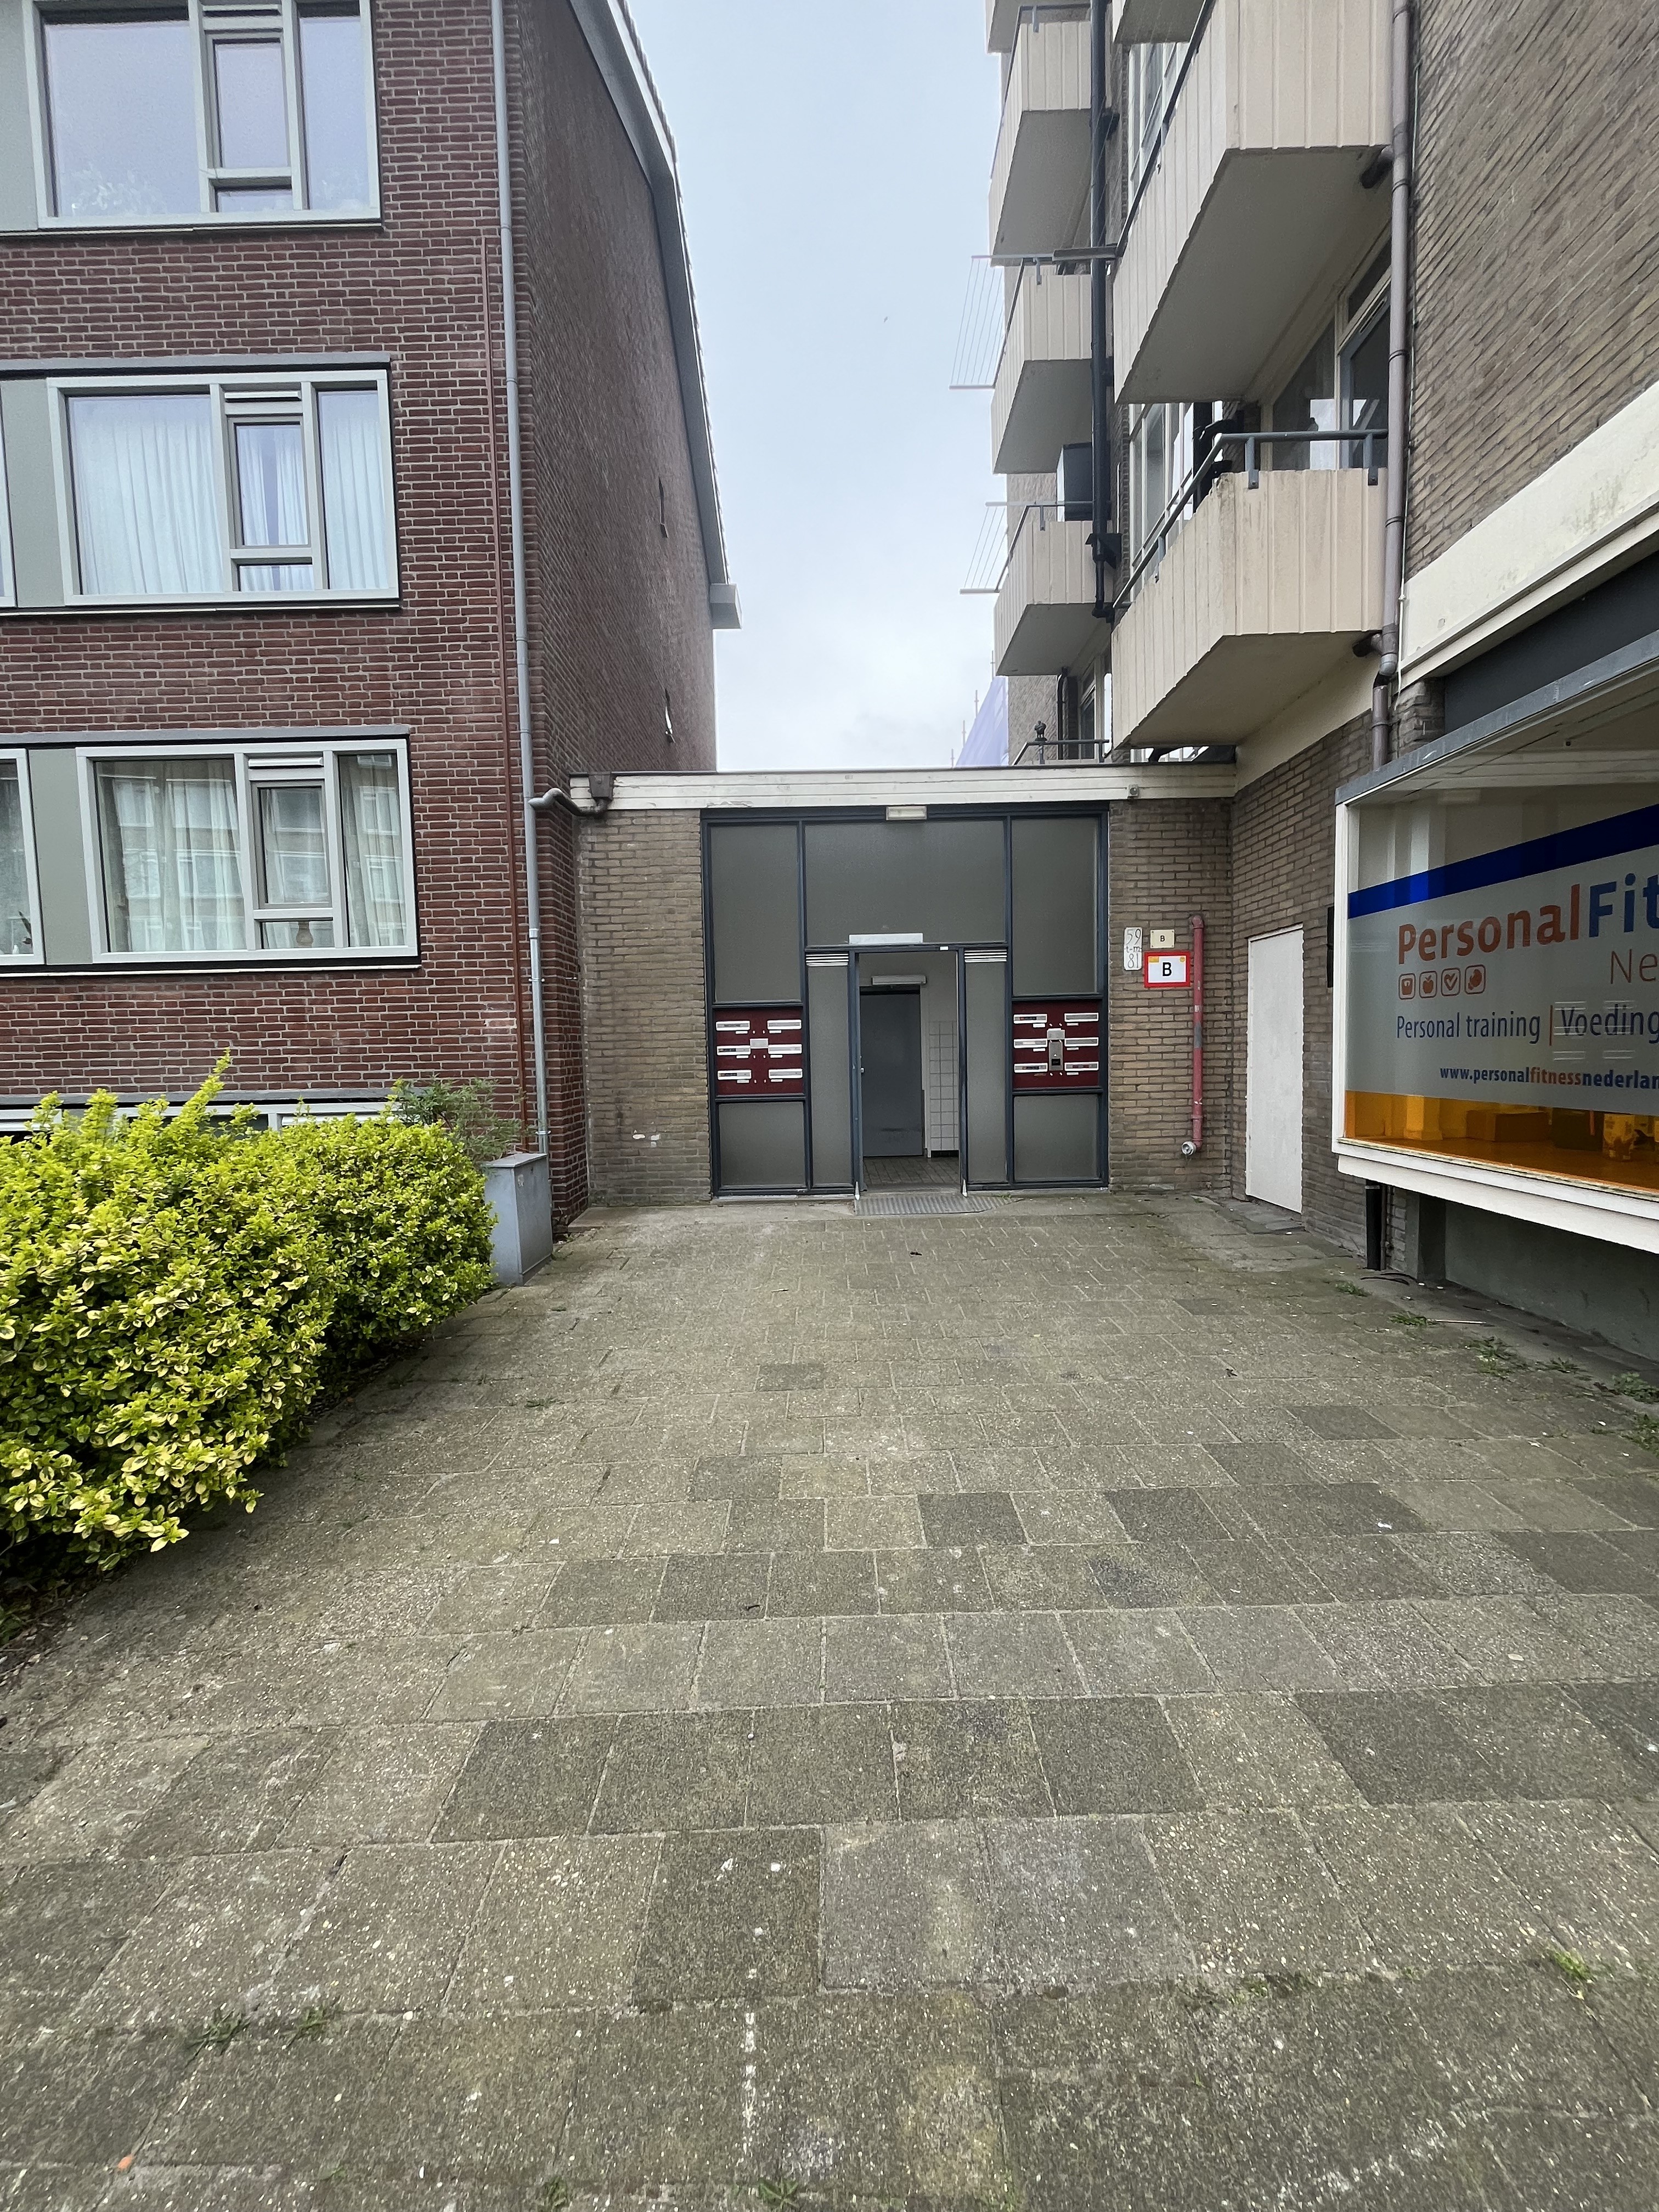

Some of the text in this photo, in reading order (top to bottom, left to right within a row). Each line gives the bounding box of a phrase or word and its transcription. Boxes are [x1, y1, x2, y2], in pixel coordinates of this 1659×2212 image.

[1126, 928, 1141, 945] 59
[1127, 953, 1139, 969] 81
[1162, 962, 1172, 977] B
[1610, 949, 1658, 984] Ne
[1397, 1003, 1659, 1044] Personal training Voeding
